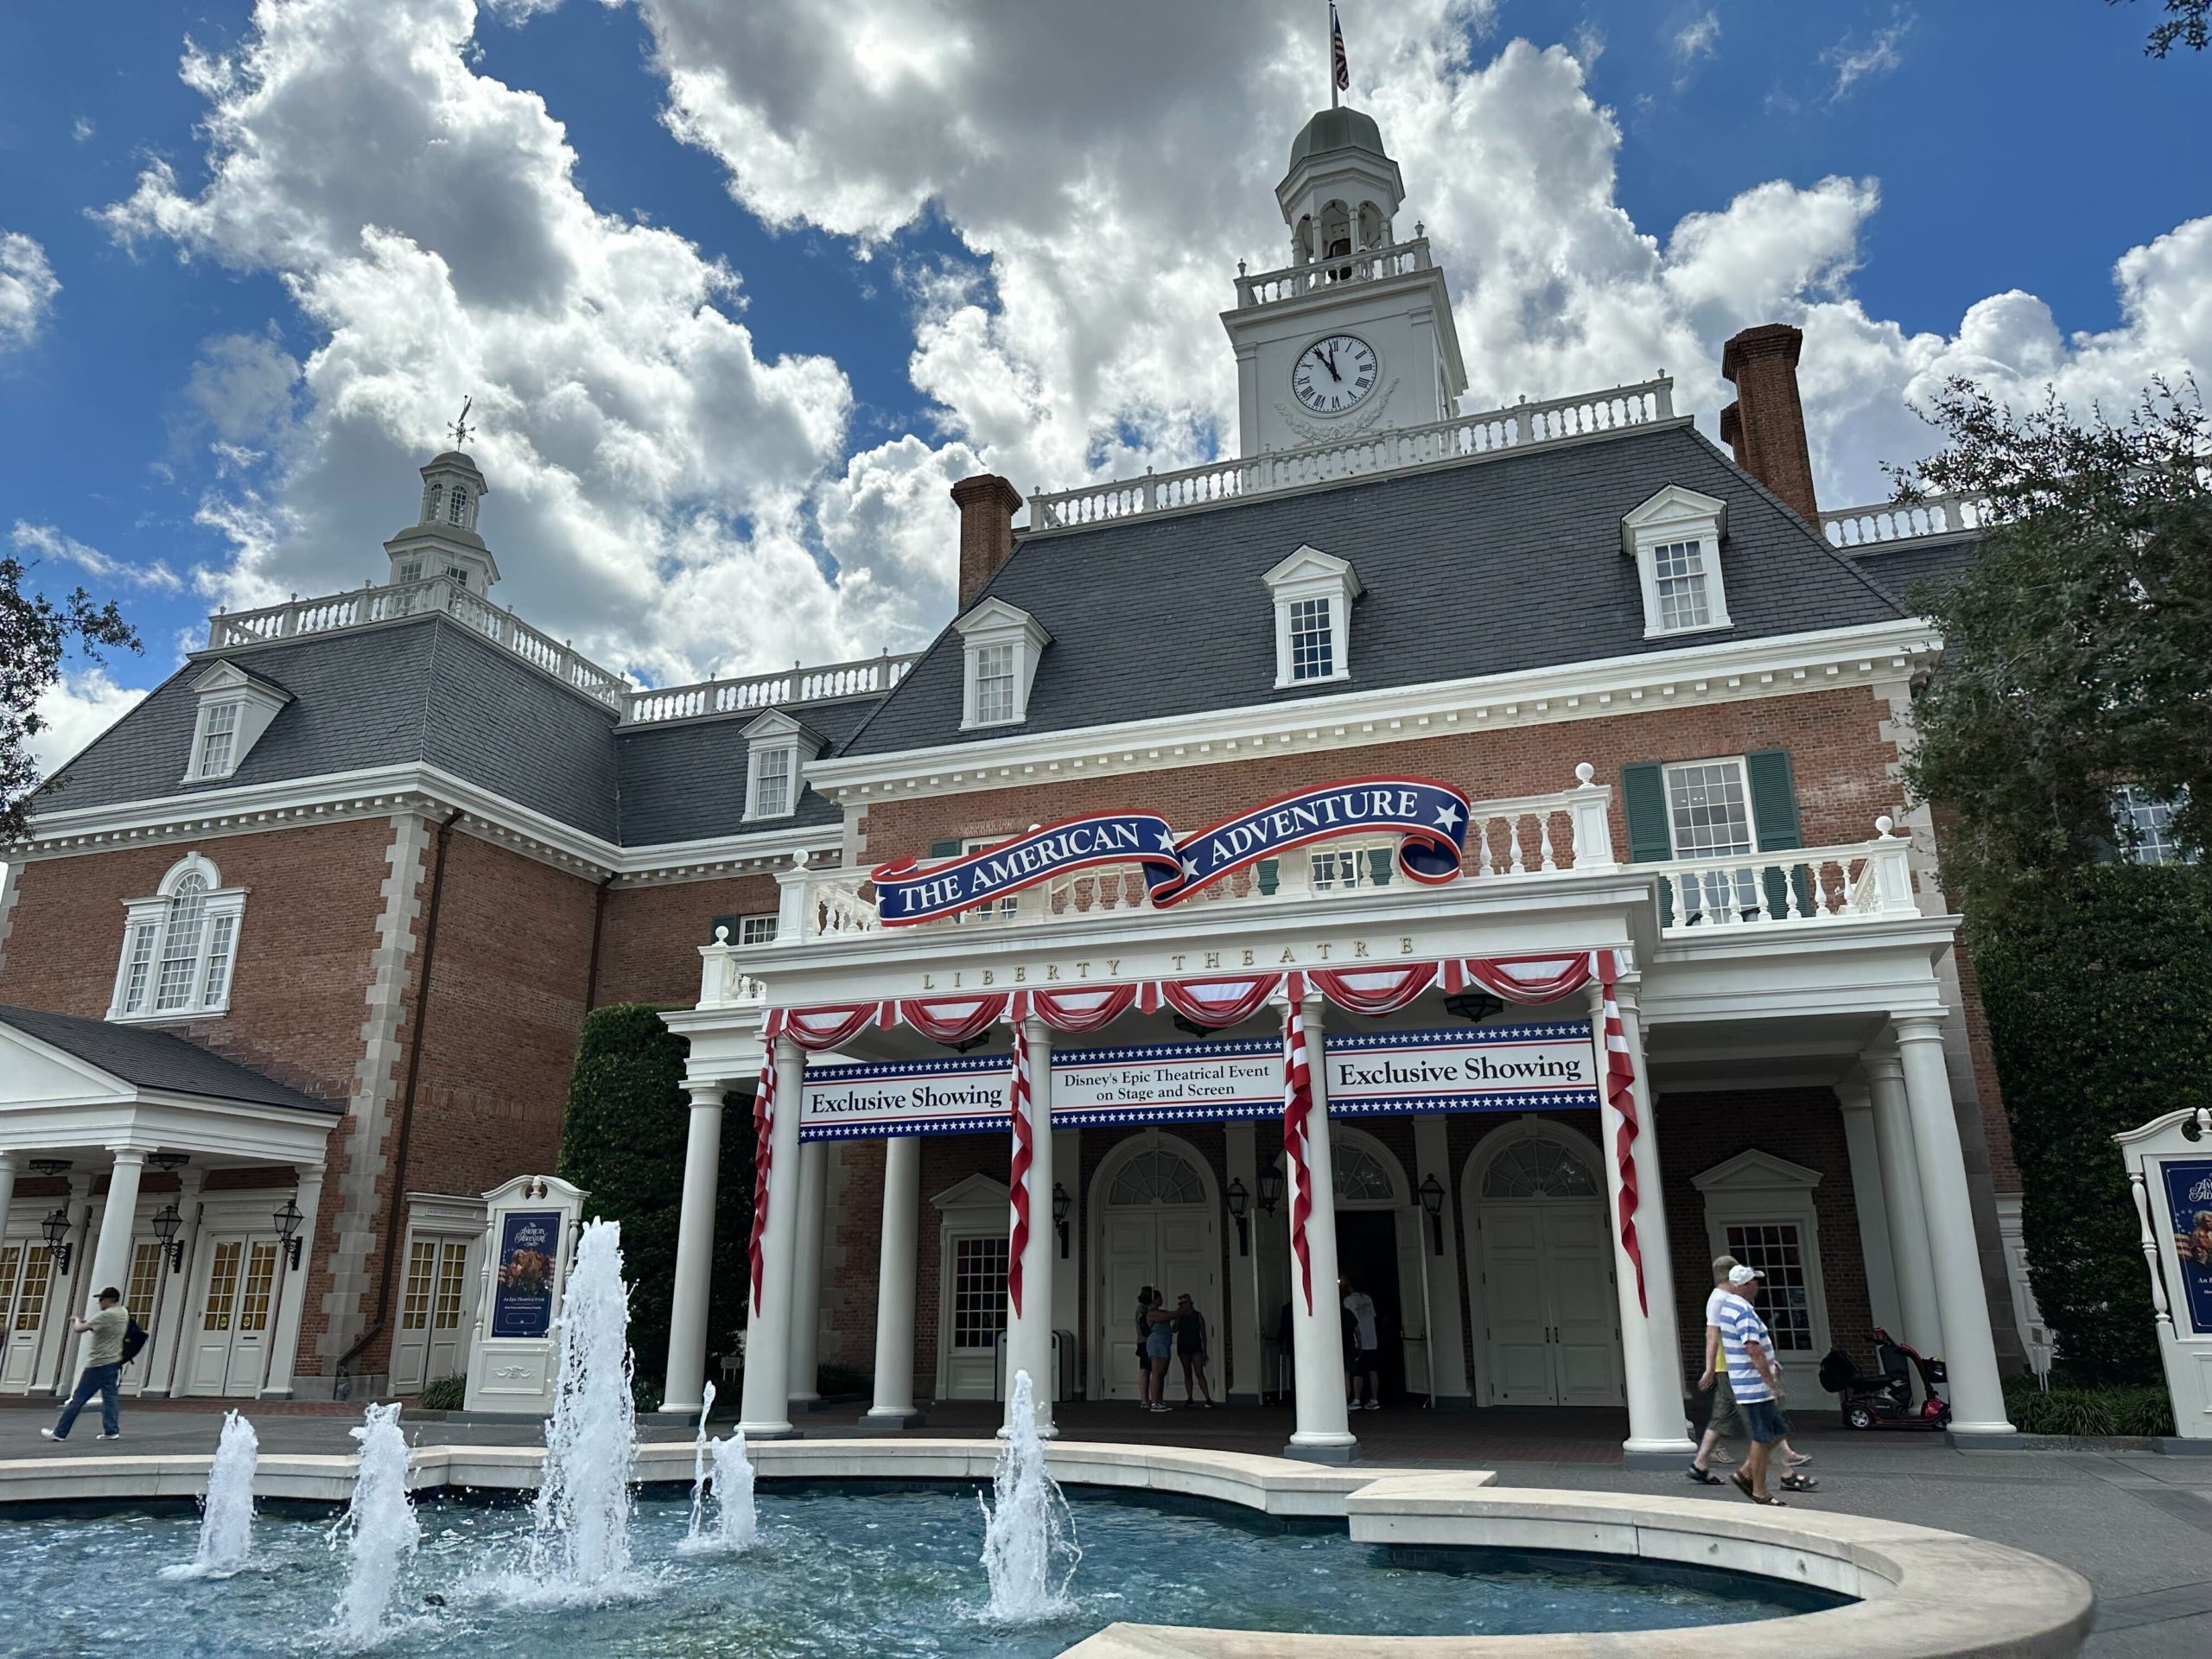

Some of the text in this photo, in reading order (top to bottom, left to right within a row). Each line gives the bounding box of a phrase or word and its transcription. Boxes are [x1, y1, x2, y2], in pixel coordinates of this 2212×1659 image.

[1345, 341, 1353, 353] I
[1355, 349, 1367, 360] II
[1298, 376, 1310, 385] IX
[1313, 394, 1325, 408] VII
[1332, 396, 1340, 408] VI
[1348, 390, 1357, 401] V
[899, 790, 1418, 912] THE AMERICAN ADVENTURE
[924, 937, 1414, 988] LIBERTY THEATRE
[1064, 1065, 1269, 1088] Disney's Epic Theatrical Event
[1338, 1055, 1581, 1085] Exclusive Showing
[810, 1084, 1002, 1114] Exclusive Showing
[1096, 1084, 1235, 1102] on Stage and Screen
